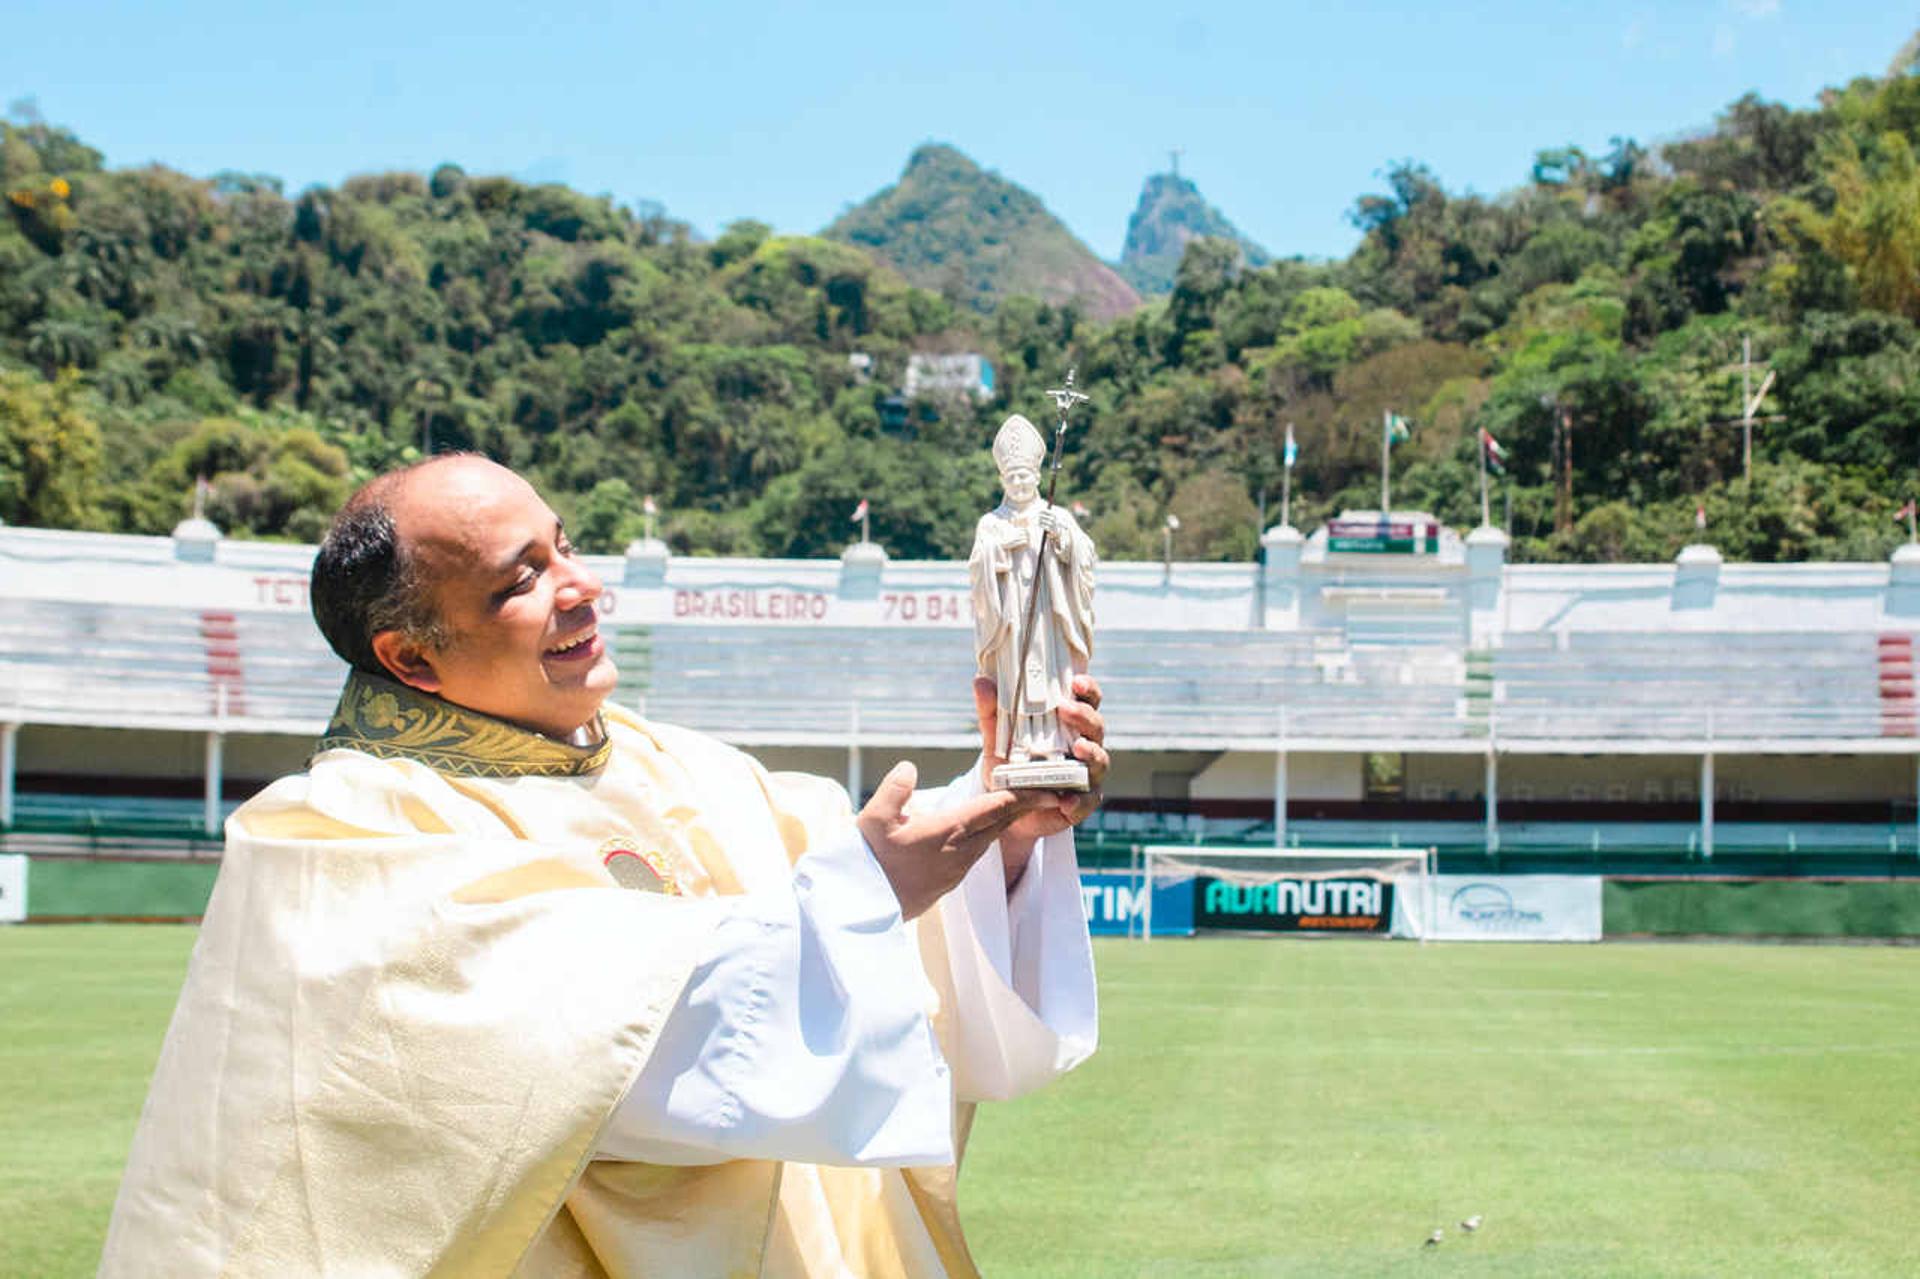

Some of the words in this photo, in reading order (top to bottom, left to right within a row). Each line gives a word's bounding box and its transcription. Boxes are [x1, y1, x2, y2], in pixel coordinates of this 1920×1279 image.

[673, 589, 827, 620] BRASILEIRO
[884, 593, 918, 621] 70
[1081, 885, 1151, 921] TIM
